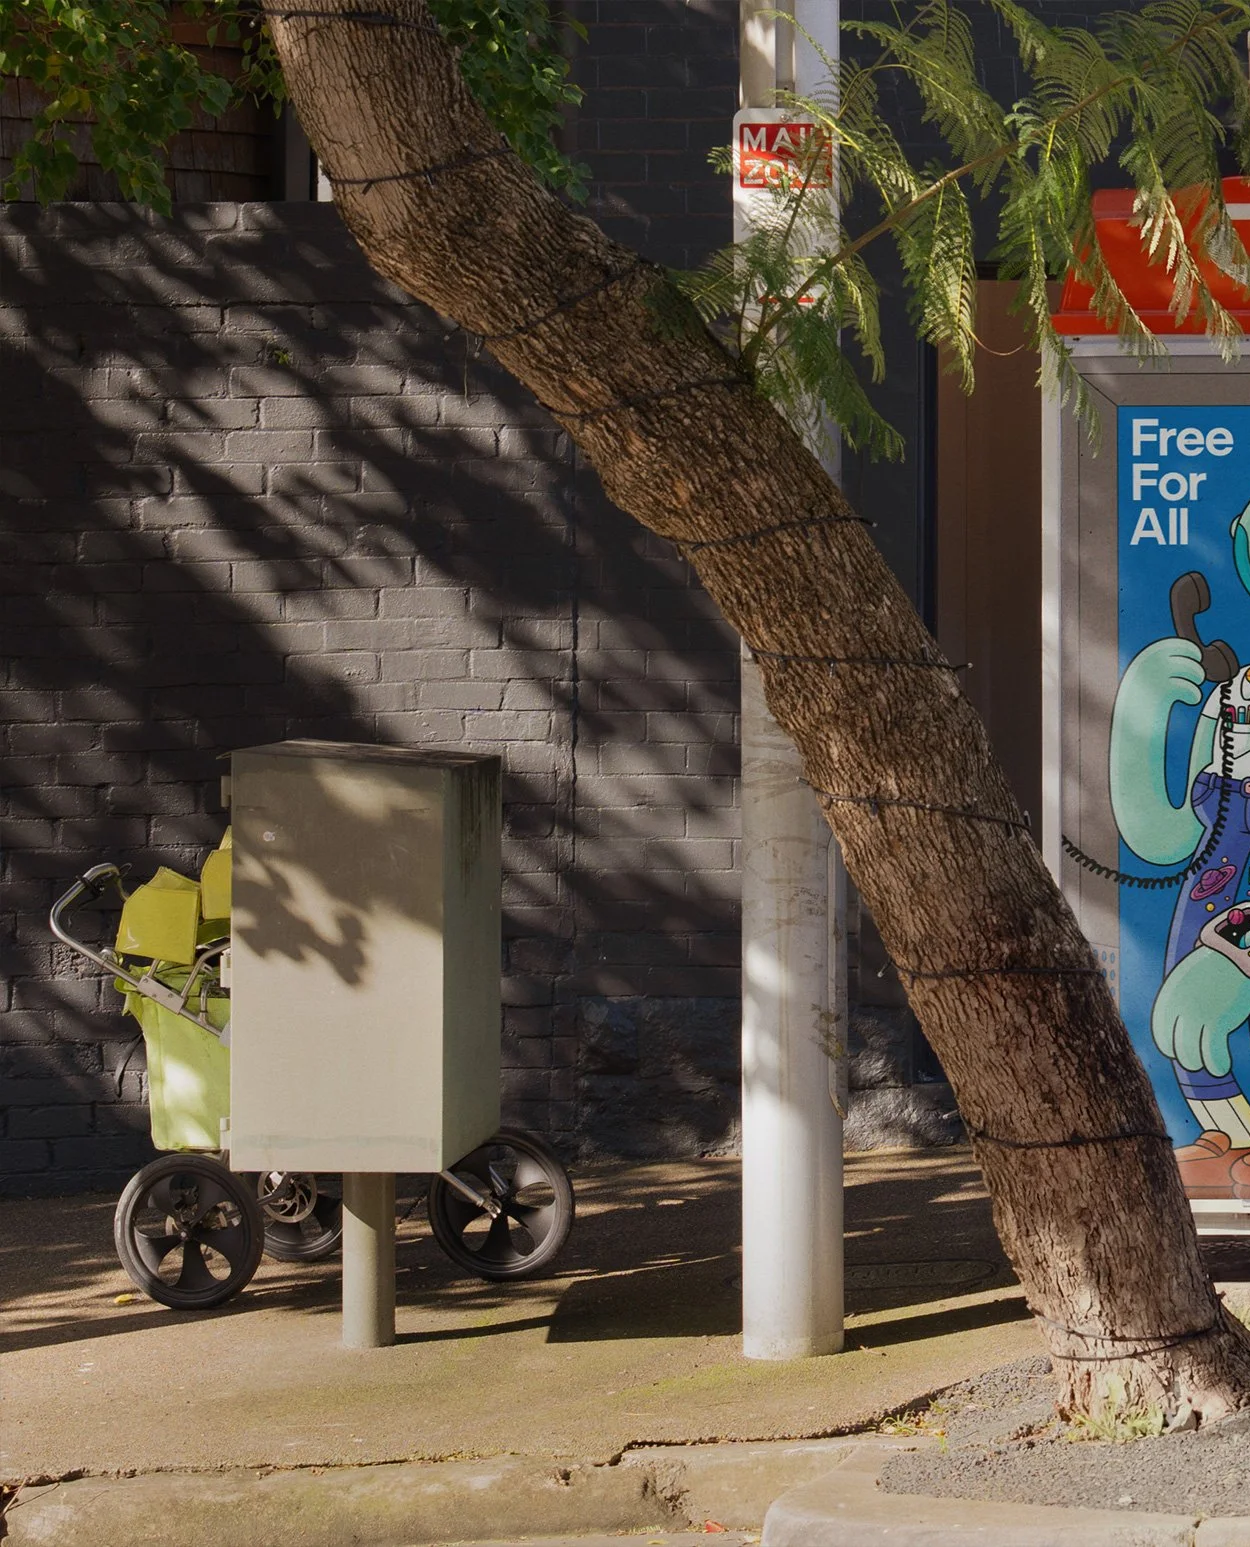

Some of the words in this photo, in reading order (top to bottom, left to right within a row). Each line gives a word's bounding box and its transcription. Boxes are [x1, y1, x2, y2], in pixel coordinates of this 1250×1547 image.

[1132, 418, 1234, 457] Free
[1132, 463, 1207, 501] For
[1130, 508, 1189, 545] All
